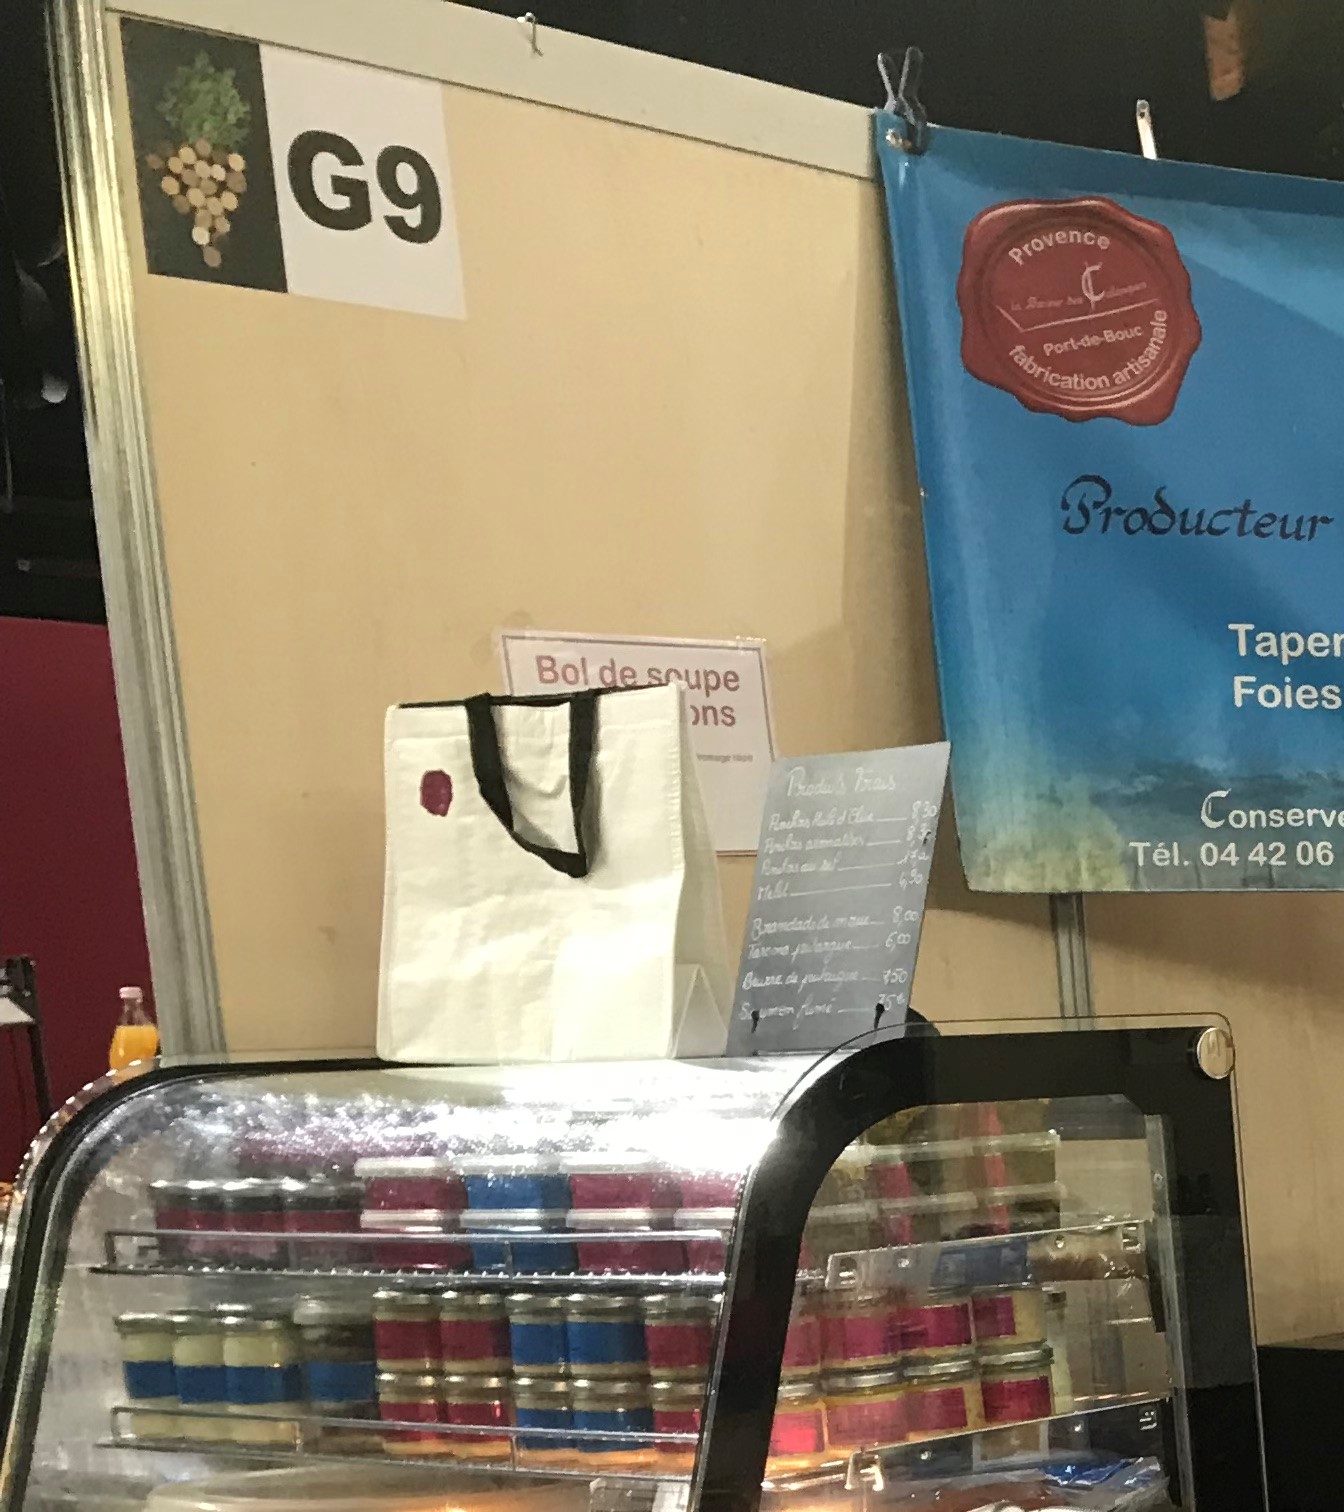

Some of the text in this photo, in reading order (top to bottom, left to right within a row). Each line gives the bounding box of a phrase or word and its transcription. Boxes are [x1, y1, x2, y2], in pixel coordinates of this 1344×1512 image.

[287, 129, 442, 244] G9
[1008, 230, 1111, 266] Provence
[1008, 309, 1168, 391] fabrication artisanale
[1043, 325, 1143, 356] Port-de-Bouc
[1061, 474, 1335, 541] Producteur
[535, 654, 740, 697] Bol de soupe
[1233, 675, 1342, 710] Foies
[1128, 842, 1190, 867] Tél.
[1200, 842, 1240, 867] 04
[1247, 842, 1287, 867] 42
[1295, 841, 1335, 866] 06
